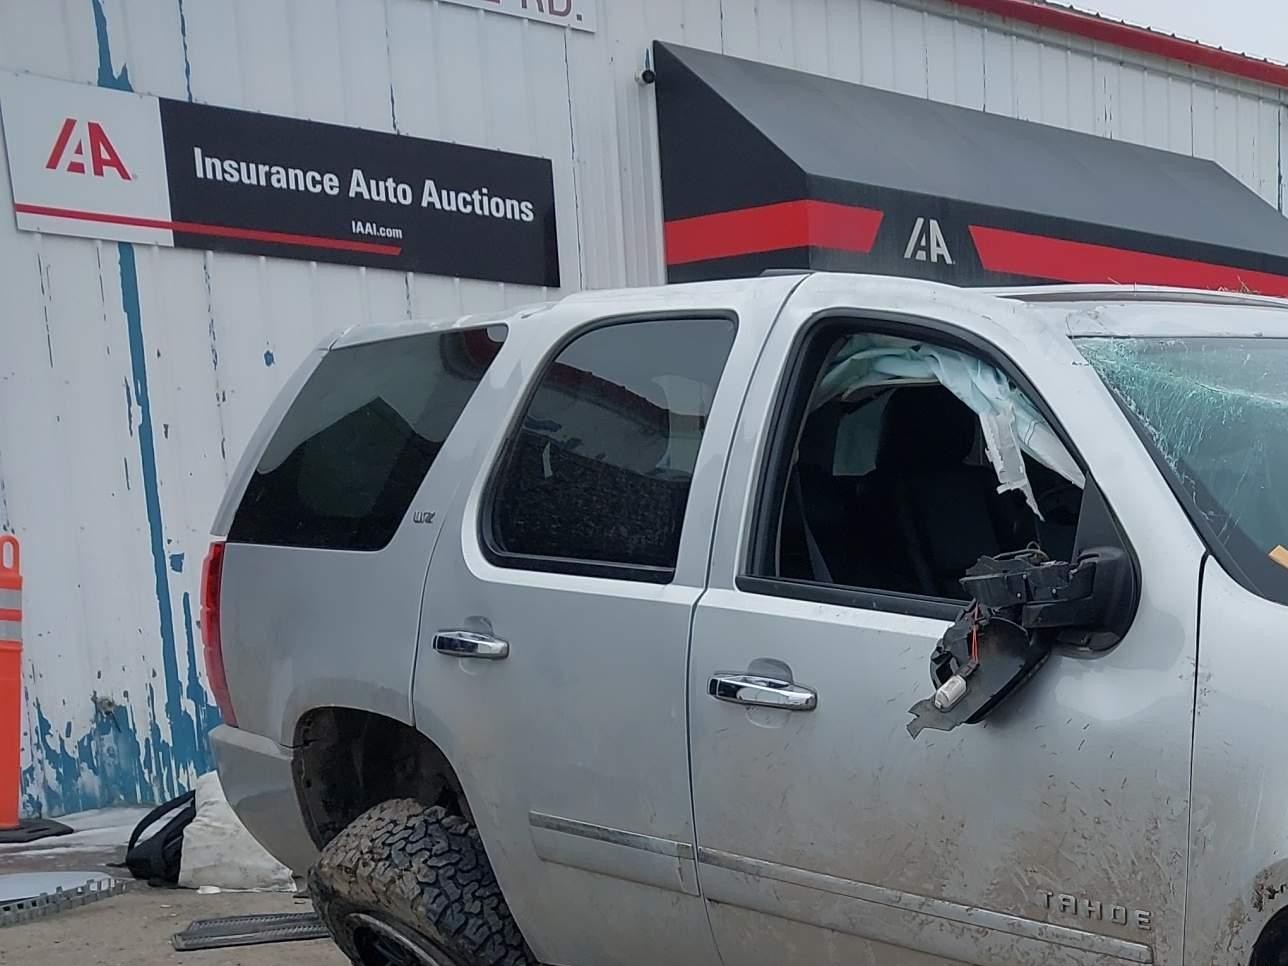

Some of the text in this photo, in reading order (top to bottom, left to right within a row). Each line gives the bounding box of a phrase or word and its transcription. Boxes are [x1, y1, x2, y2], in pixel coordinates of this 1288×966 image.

[194, 147, 534, 223] Insurance Auto Auctions
[352, 220, 403, 239] IAAI.com
[1038, 889, 1152, 931] TAHOE
